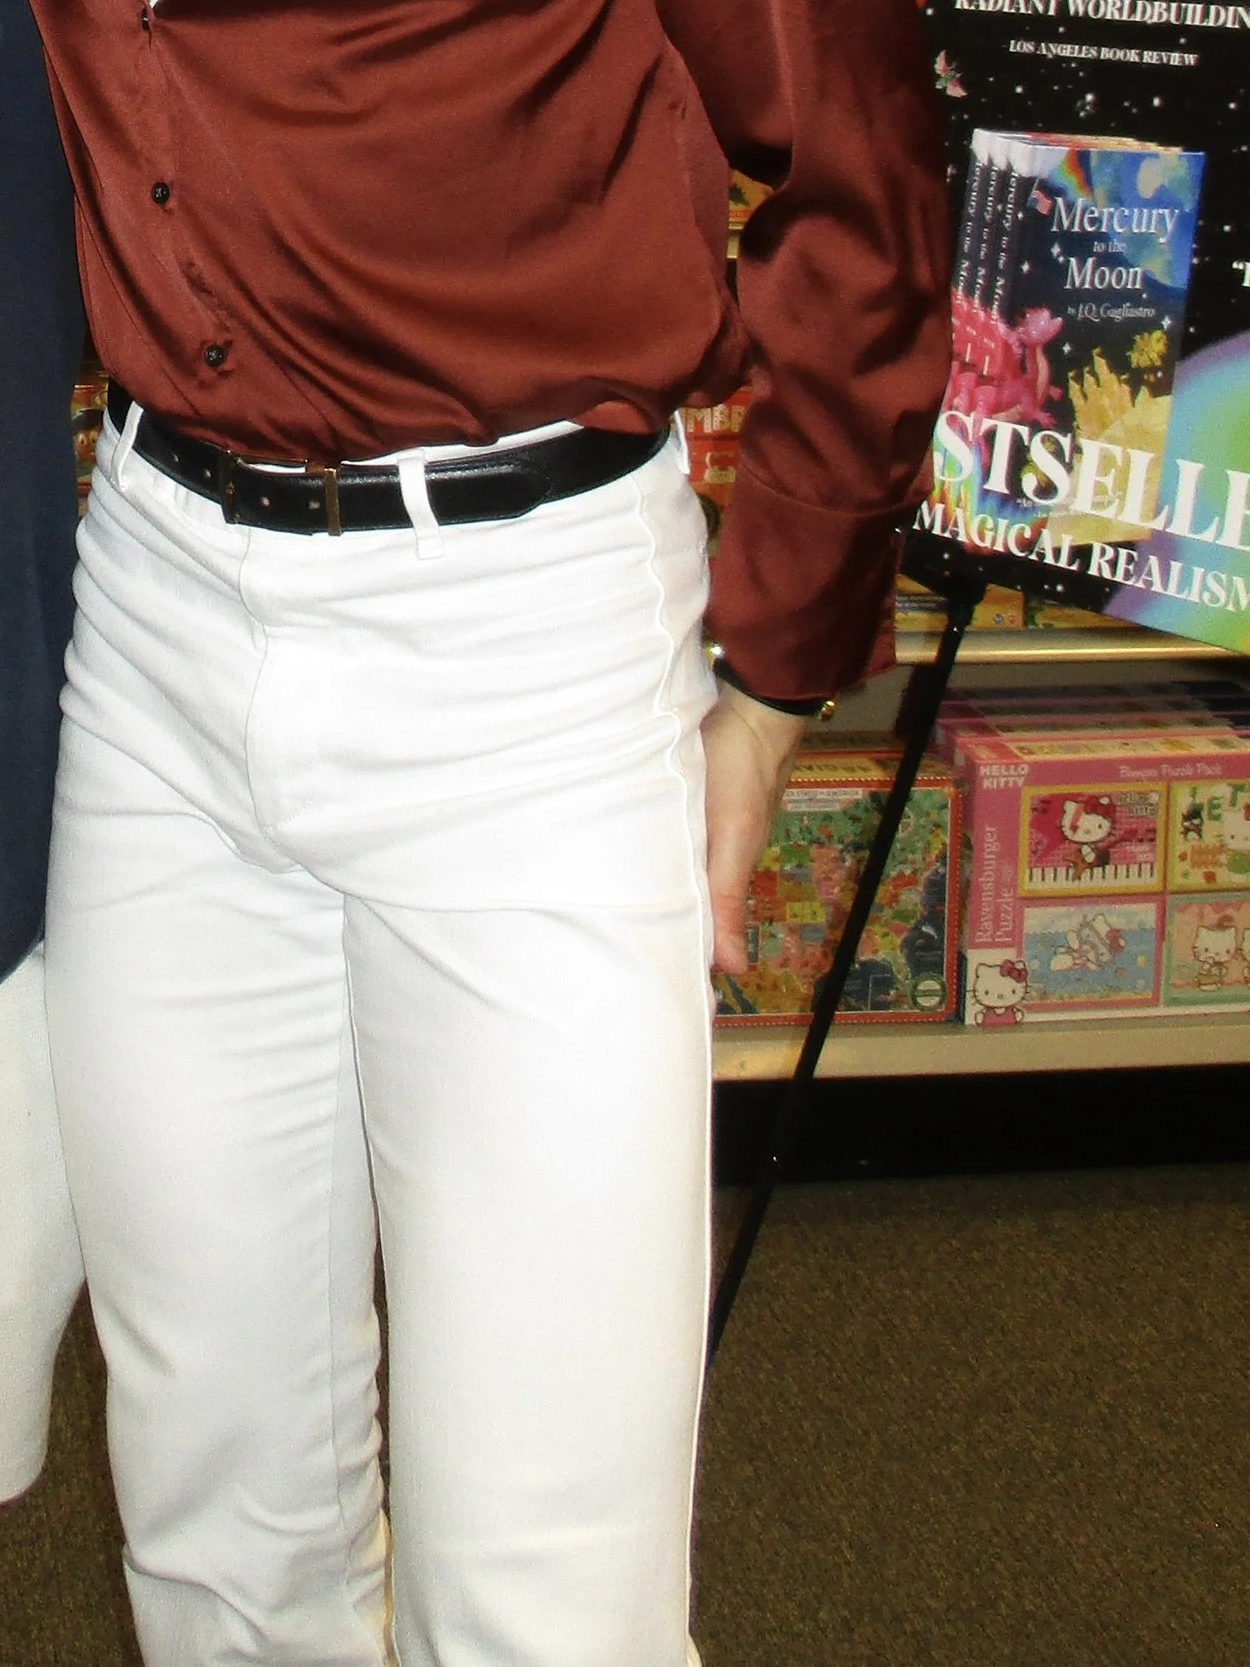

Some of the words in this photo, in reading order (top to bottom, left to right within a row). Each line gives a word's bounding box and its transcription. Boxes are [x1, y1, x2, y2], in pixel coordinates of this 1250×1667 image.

[1009, 39, 1035, 54] LOS
[1036, 41, 1098, 60] ANGELES
[1100, 46, 1140, 63] BOOK
[1142, 50, 1200, 67] REVIEW
[1051, 196, 1180, 243] Mercury
[1093, 240, 1105, 253] to
[1108, 239, 1127, 253] the
[1064, 256, 1143, 290] Moon
[912, 500, 1081, 572] MAGICAL
[980, 764, 1029, 776] HELLO
[983, 777, 1026, 789] KITTY
[975, 825, 1001, 943] Ravensburger
[995, 887, 1013, 943] Puzzle
